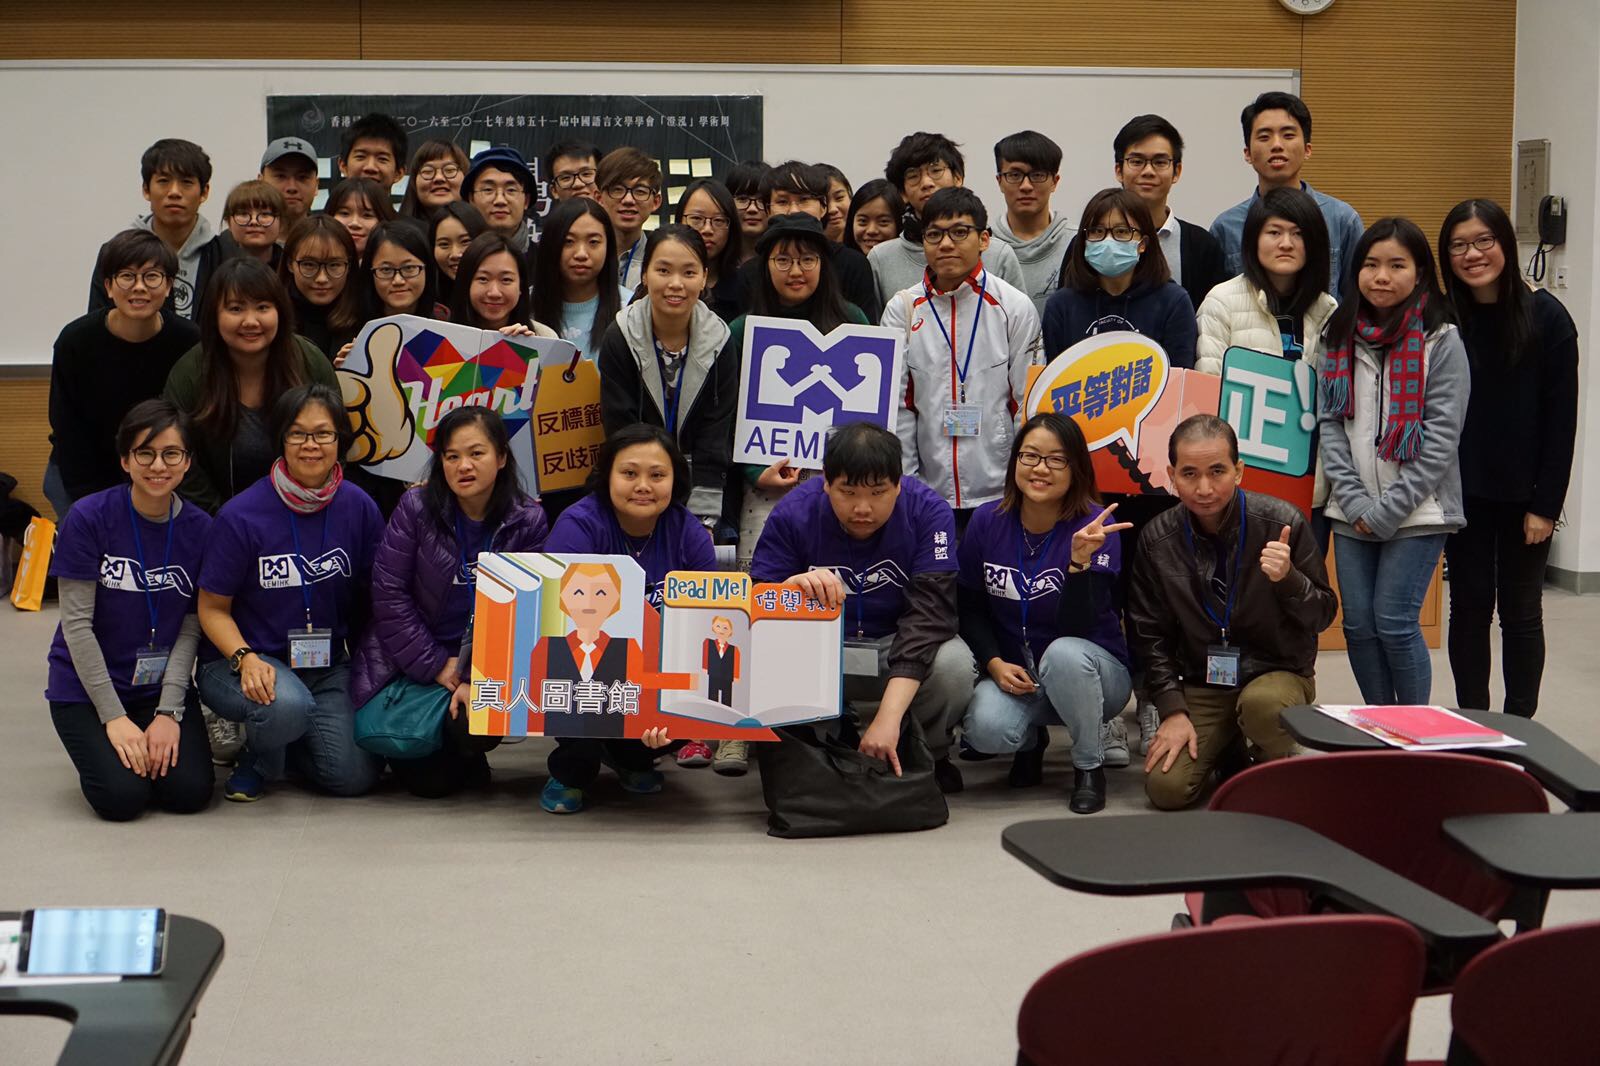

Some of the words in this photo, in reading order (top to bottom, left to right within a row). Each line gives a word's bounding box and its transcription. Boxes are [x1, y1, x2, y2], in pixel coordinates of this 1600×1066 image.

[1051, 355, 1153, 420] 平等對話
[262, 579, 290, 589] AEMIHK
[667, 576, 708, 600] Read
[711, 578, 748, 601] Me!
[755, 589, 837, 612] 借閱我
[471, 678, 642, 715] 真人圖書館
